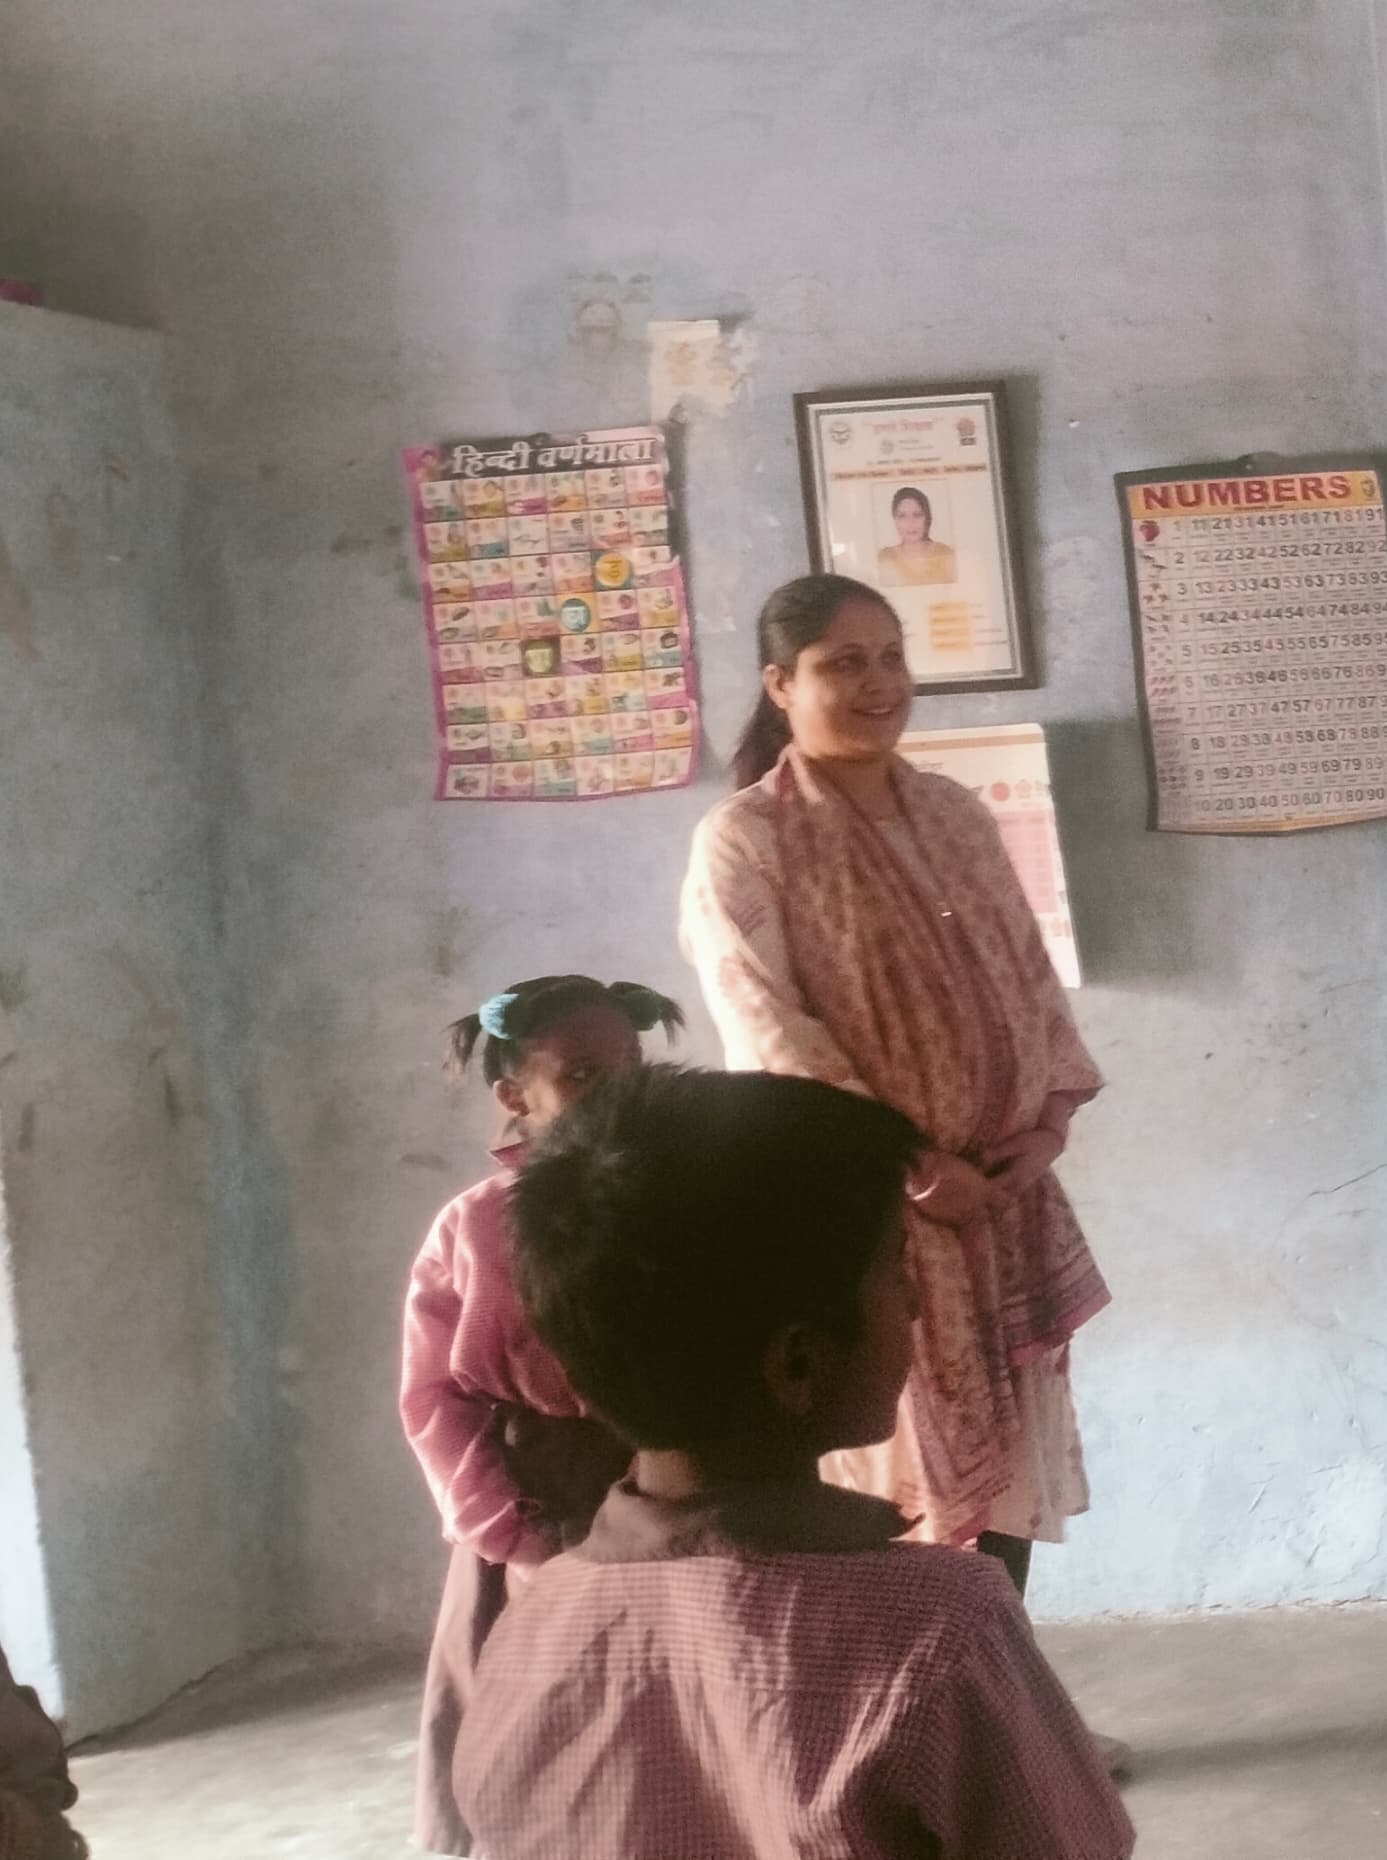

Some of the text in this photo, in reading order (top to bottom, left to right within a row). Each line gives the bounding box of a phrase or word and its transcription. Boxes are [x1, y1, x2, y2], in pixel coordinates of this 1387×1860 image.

[453, 433, 660, 478] हिन्दी वर्णमाला
[1142, 475, 1351, 510] NUMBERS
